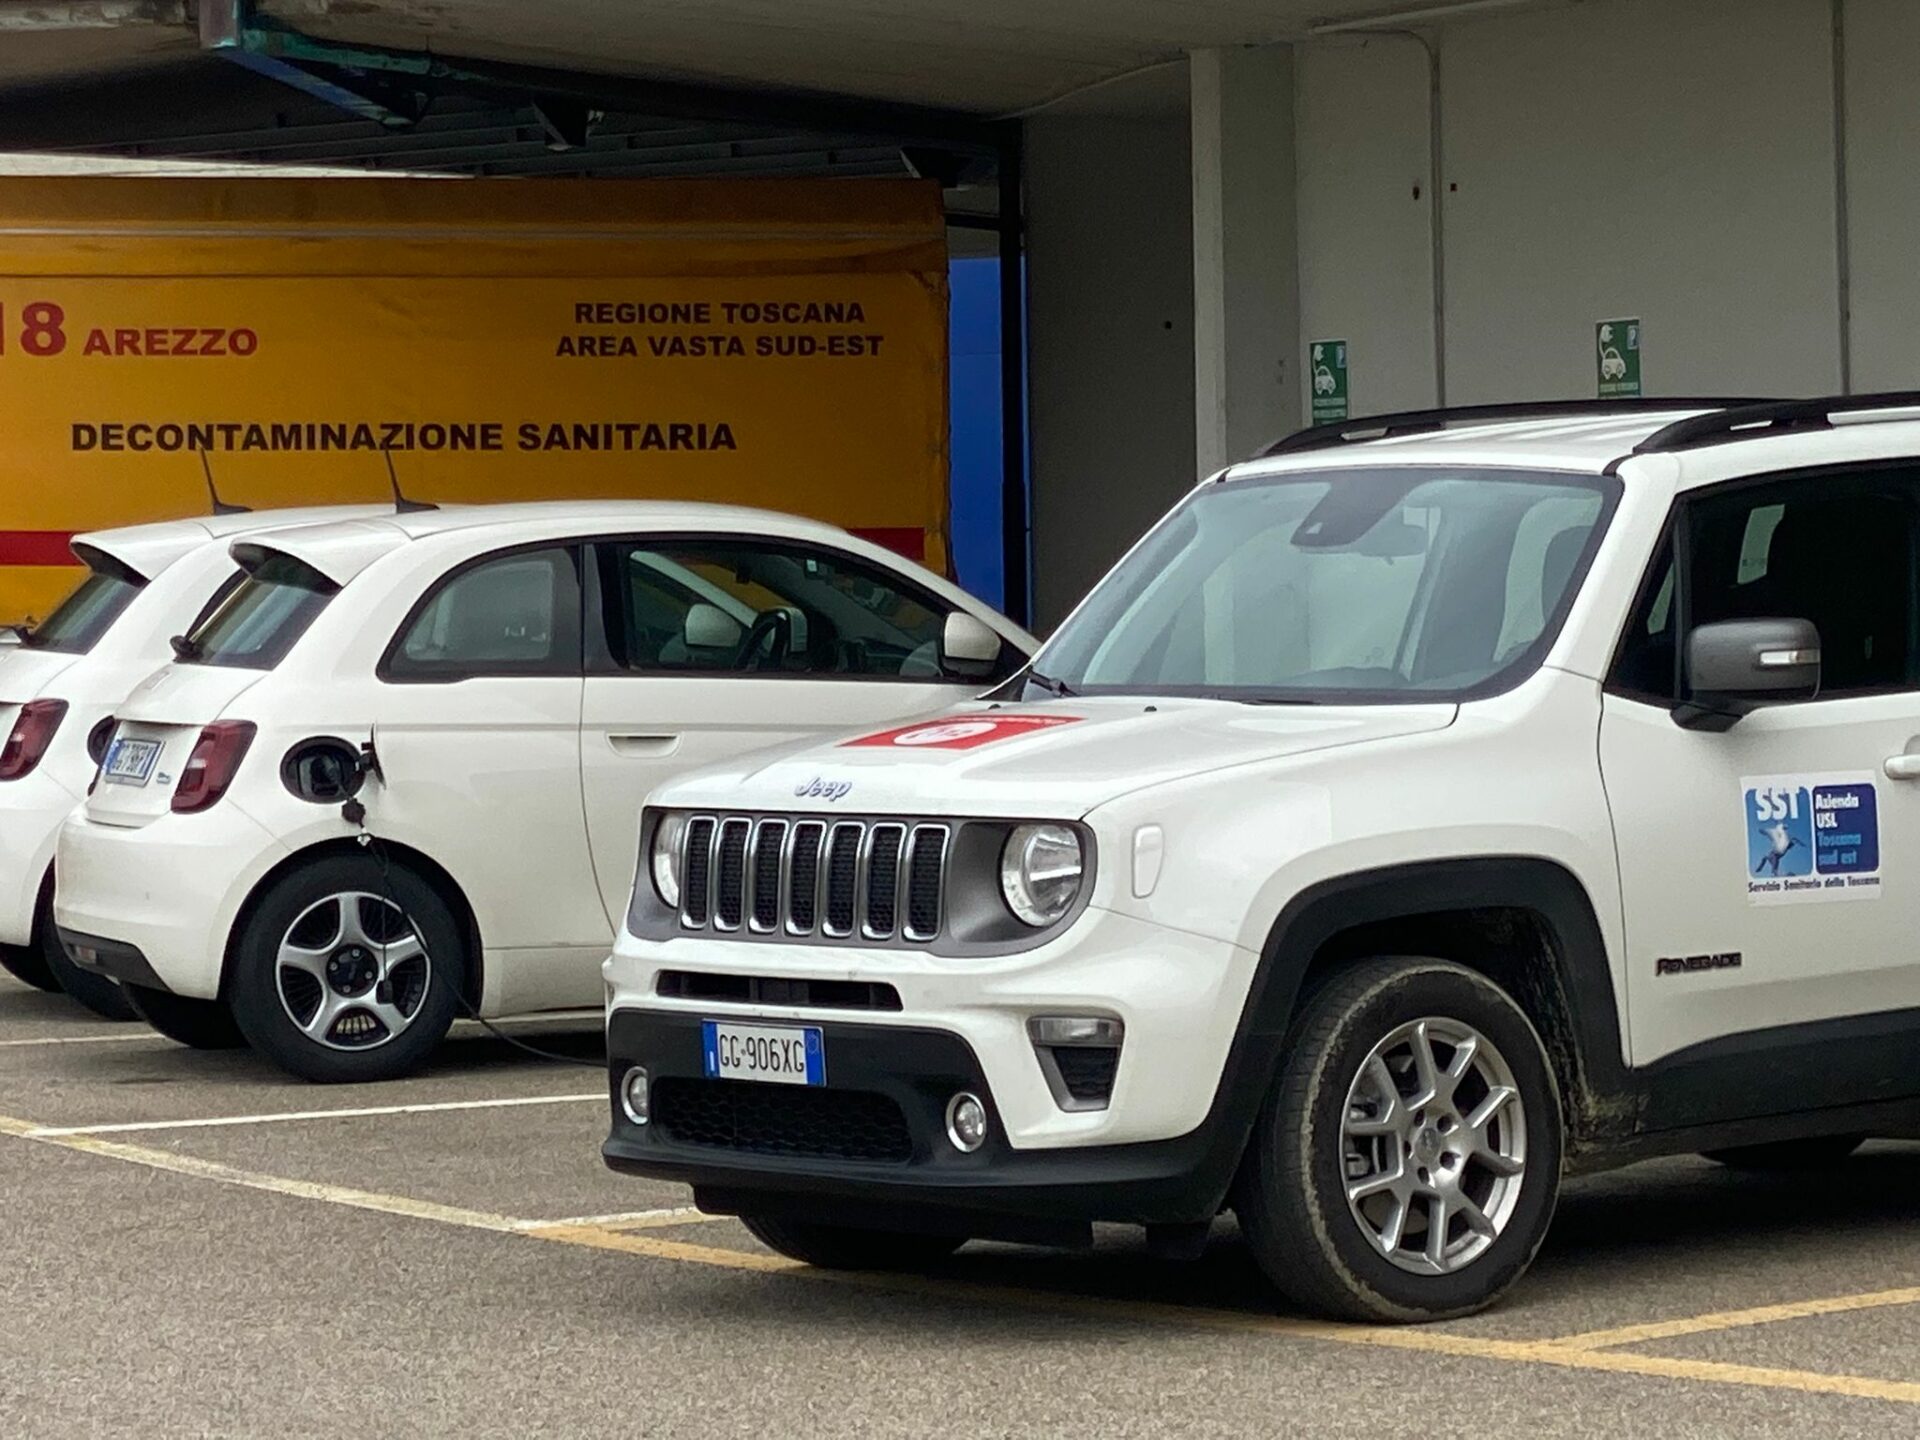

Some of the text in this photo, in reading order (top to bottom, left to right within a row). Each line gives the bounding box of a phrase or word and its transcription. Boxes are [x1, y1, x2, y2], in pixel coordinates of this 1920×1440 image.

[575, 303, 865, 323] REGIONE TOSCANA
[0, 302, 258, 356] 8 AREZZO
[556, 335, 884, 357] AREA VASTA SUD-EST
[72, 423, 737, 451] DECONTAMINAZIONE SANITARIA
[794, 777, 852, 802] Jeep
[1815, 792, 1859, 810] Azienda
[1755, 786, 1799, 821] SST
[1816, 811, 1838, 829] USL
[1655, 952, 1742, 977] RENEGADE
